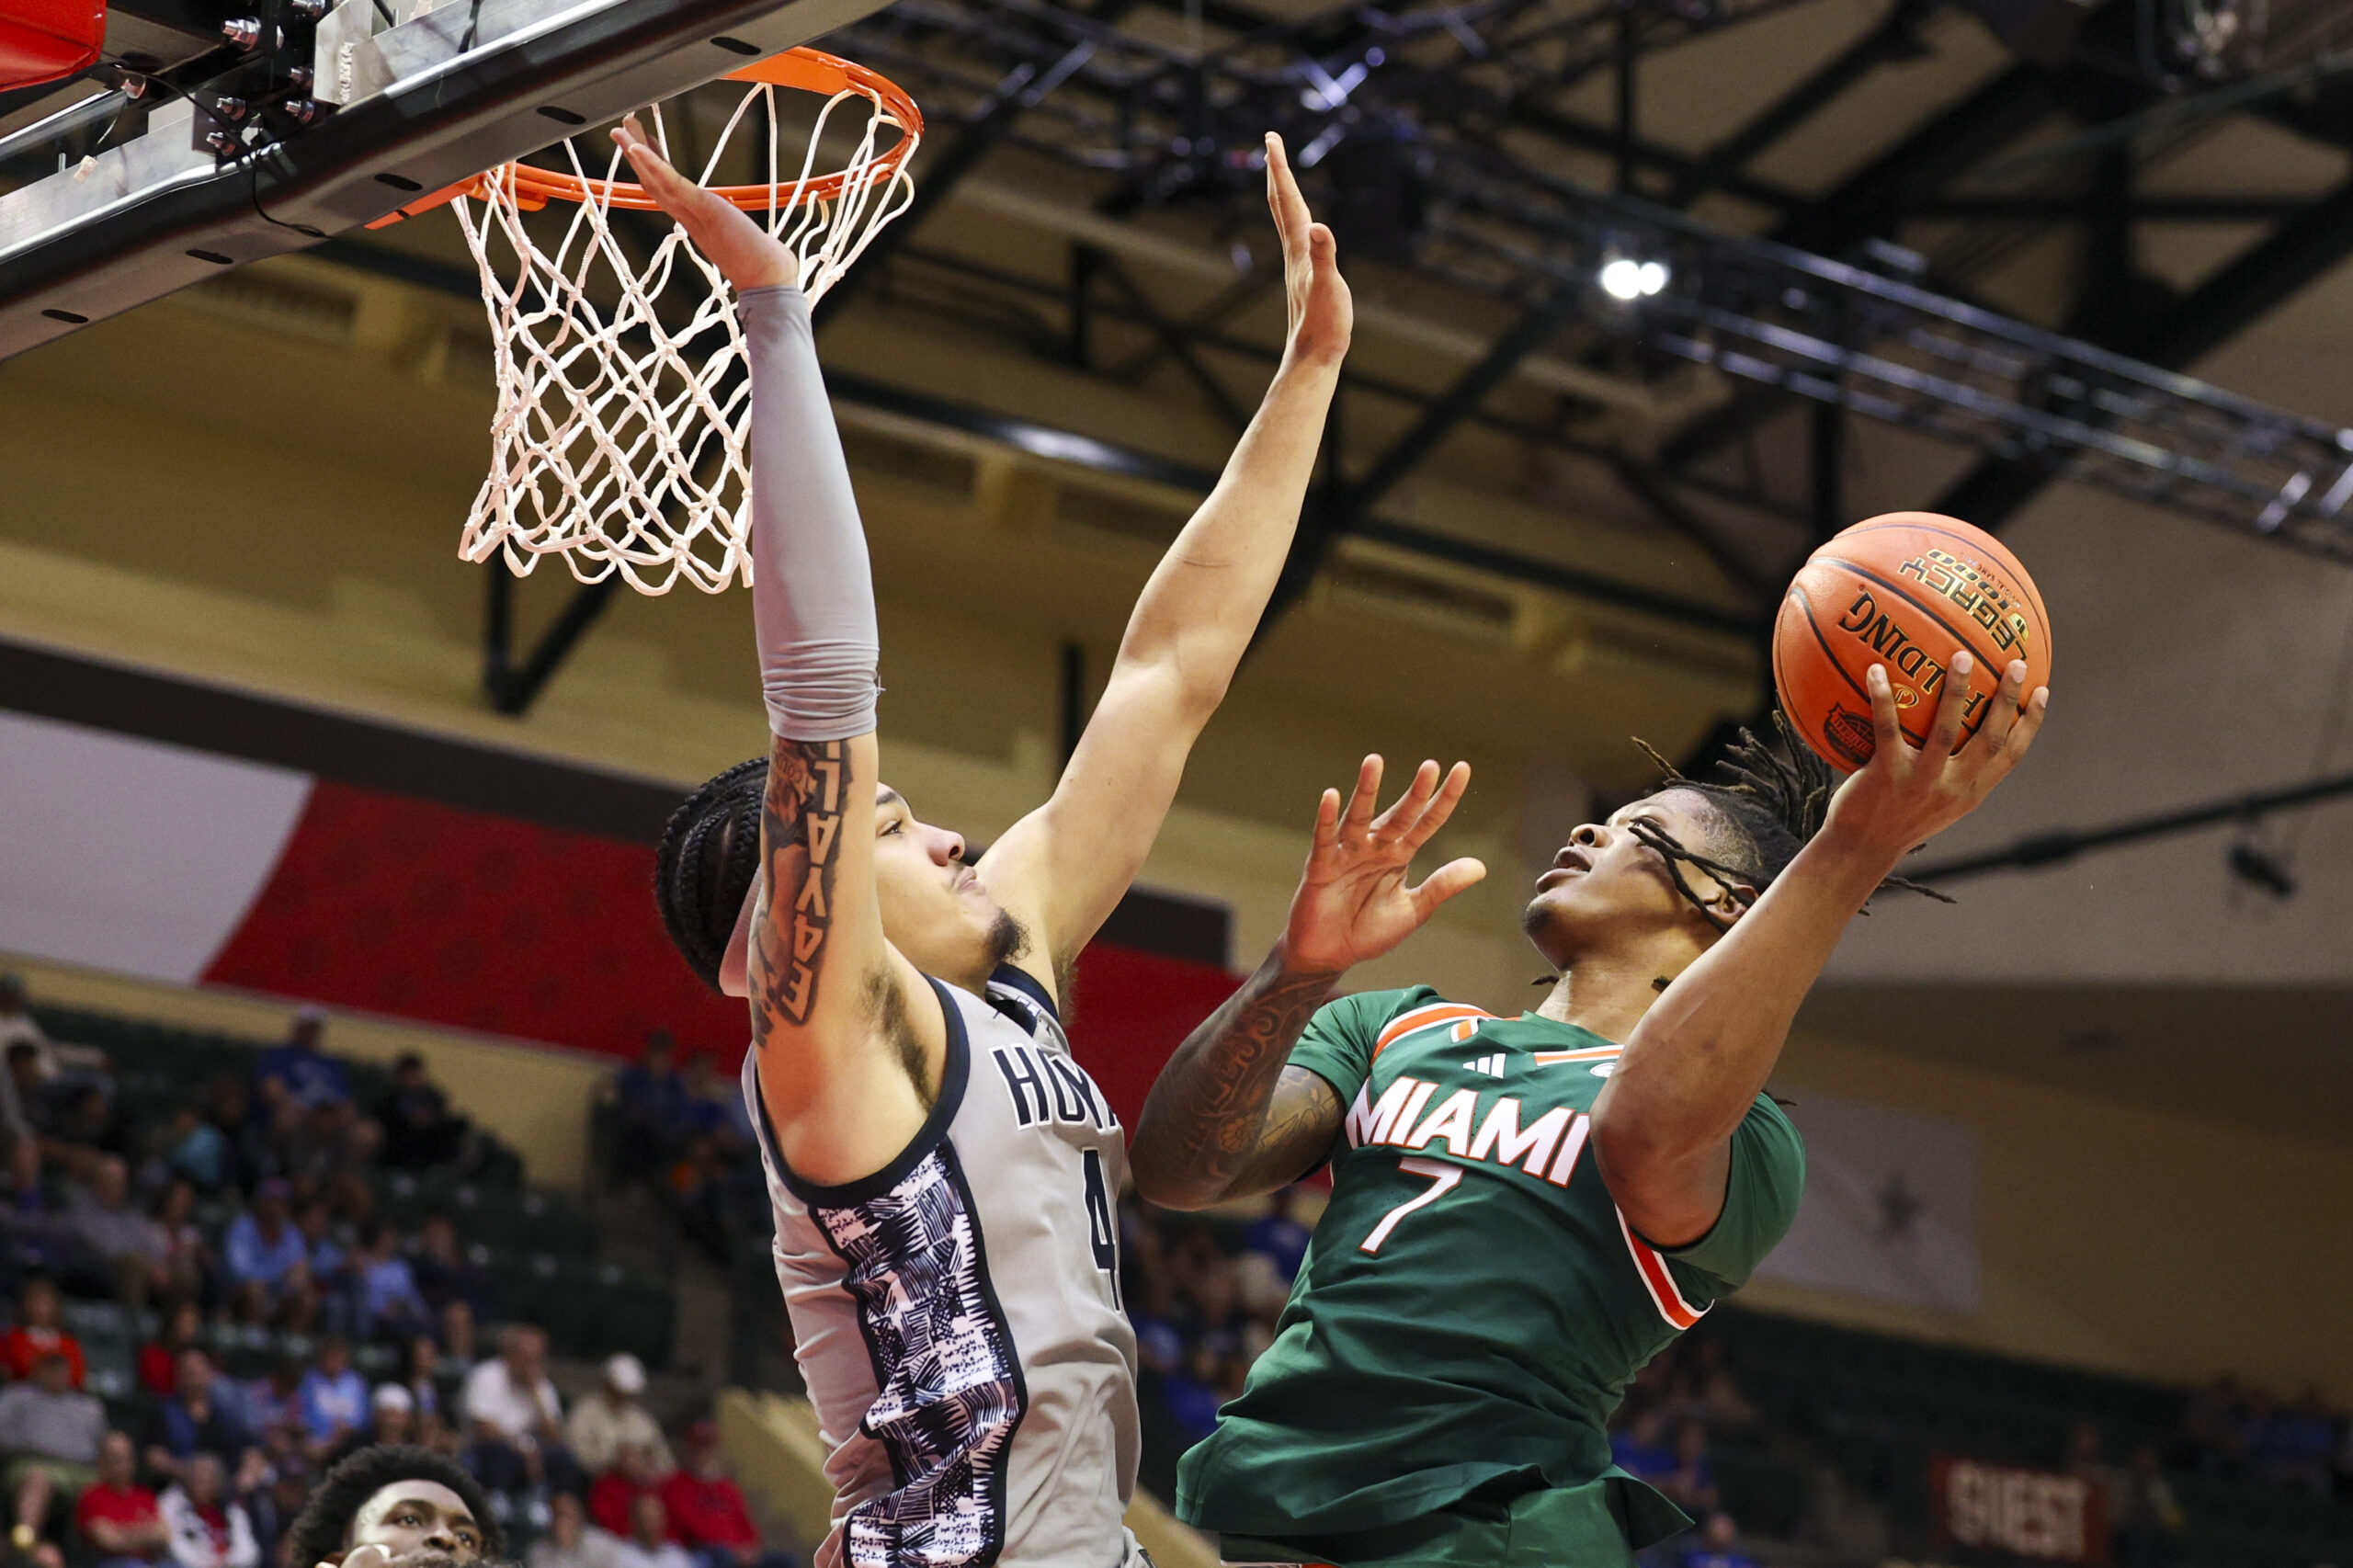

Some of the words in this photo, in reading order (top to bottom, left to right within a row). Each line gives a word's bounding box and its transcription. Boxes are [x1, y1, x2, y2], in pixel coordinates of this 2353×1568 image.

[989, 1044, 1121, 1135] HOY
[1345, 1075, 1590, 1188] MIAMI
[1358, 1156, 1466, 1255] 7
